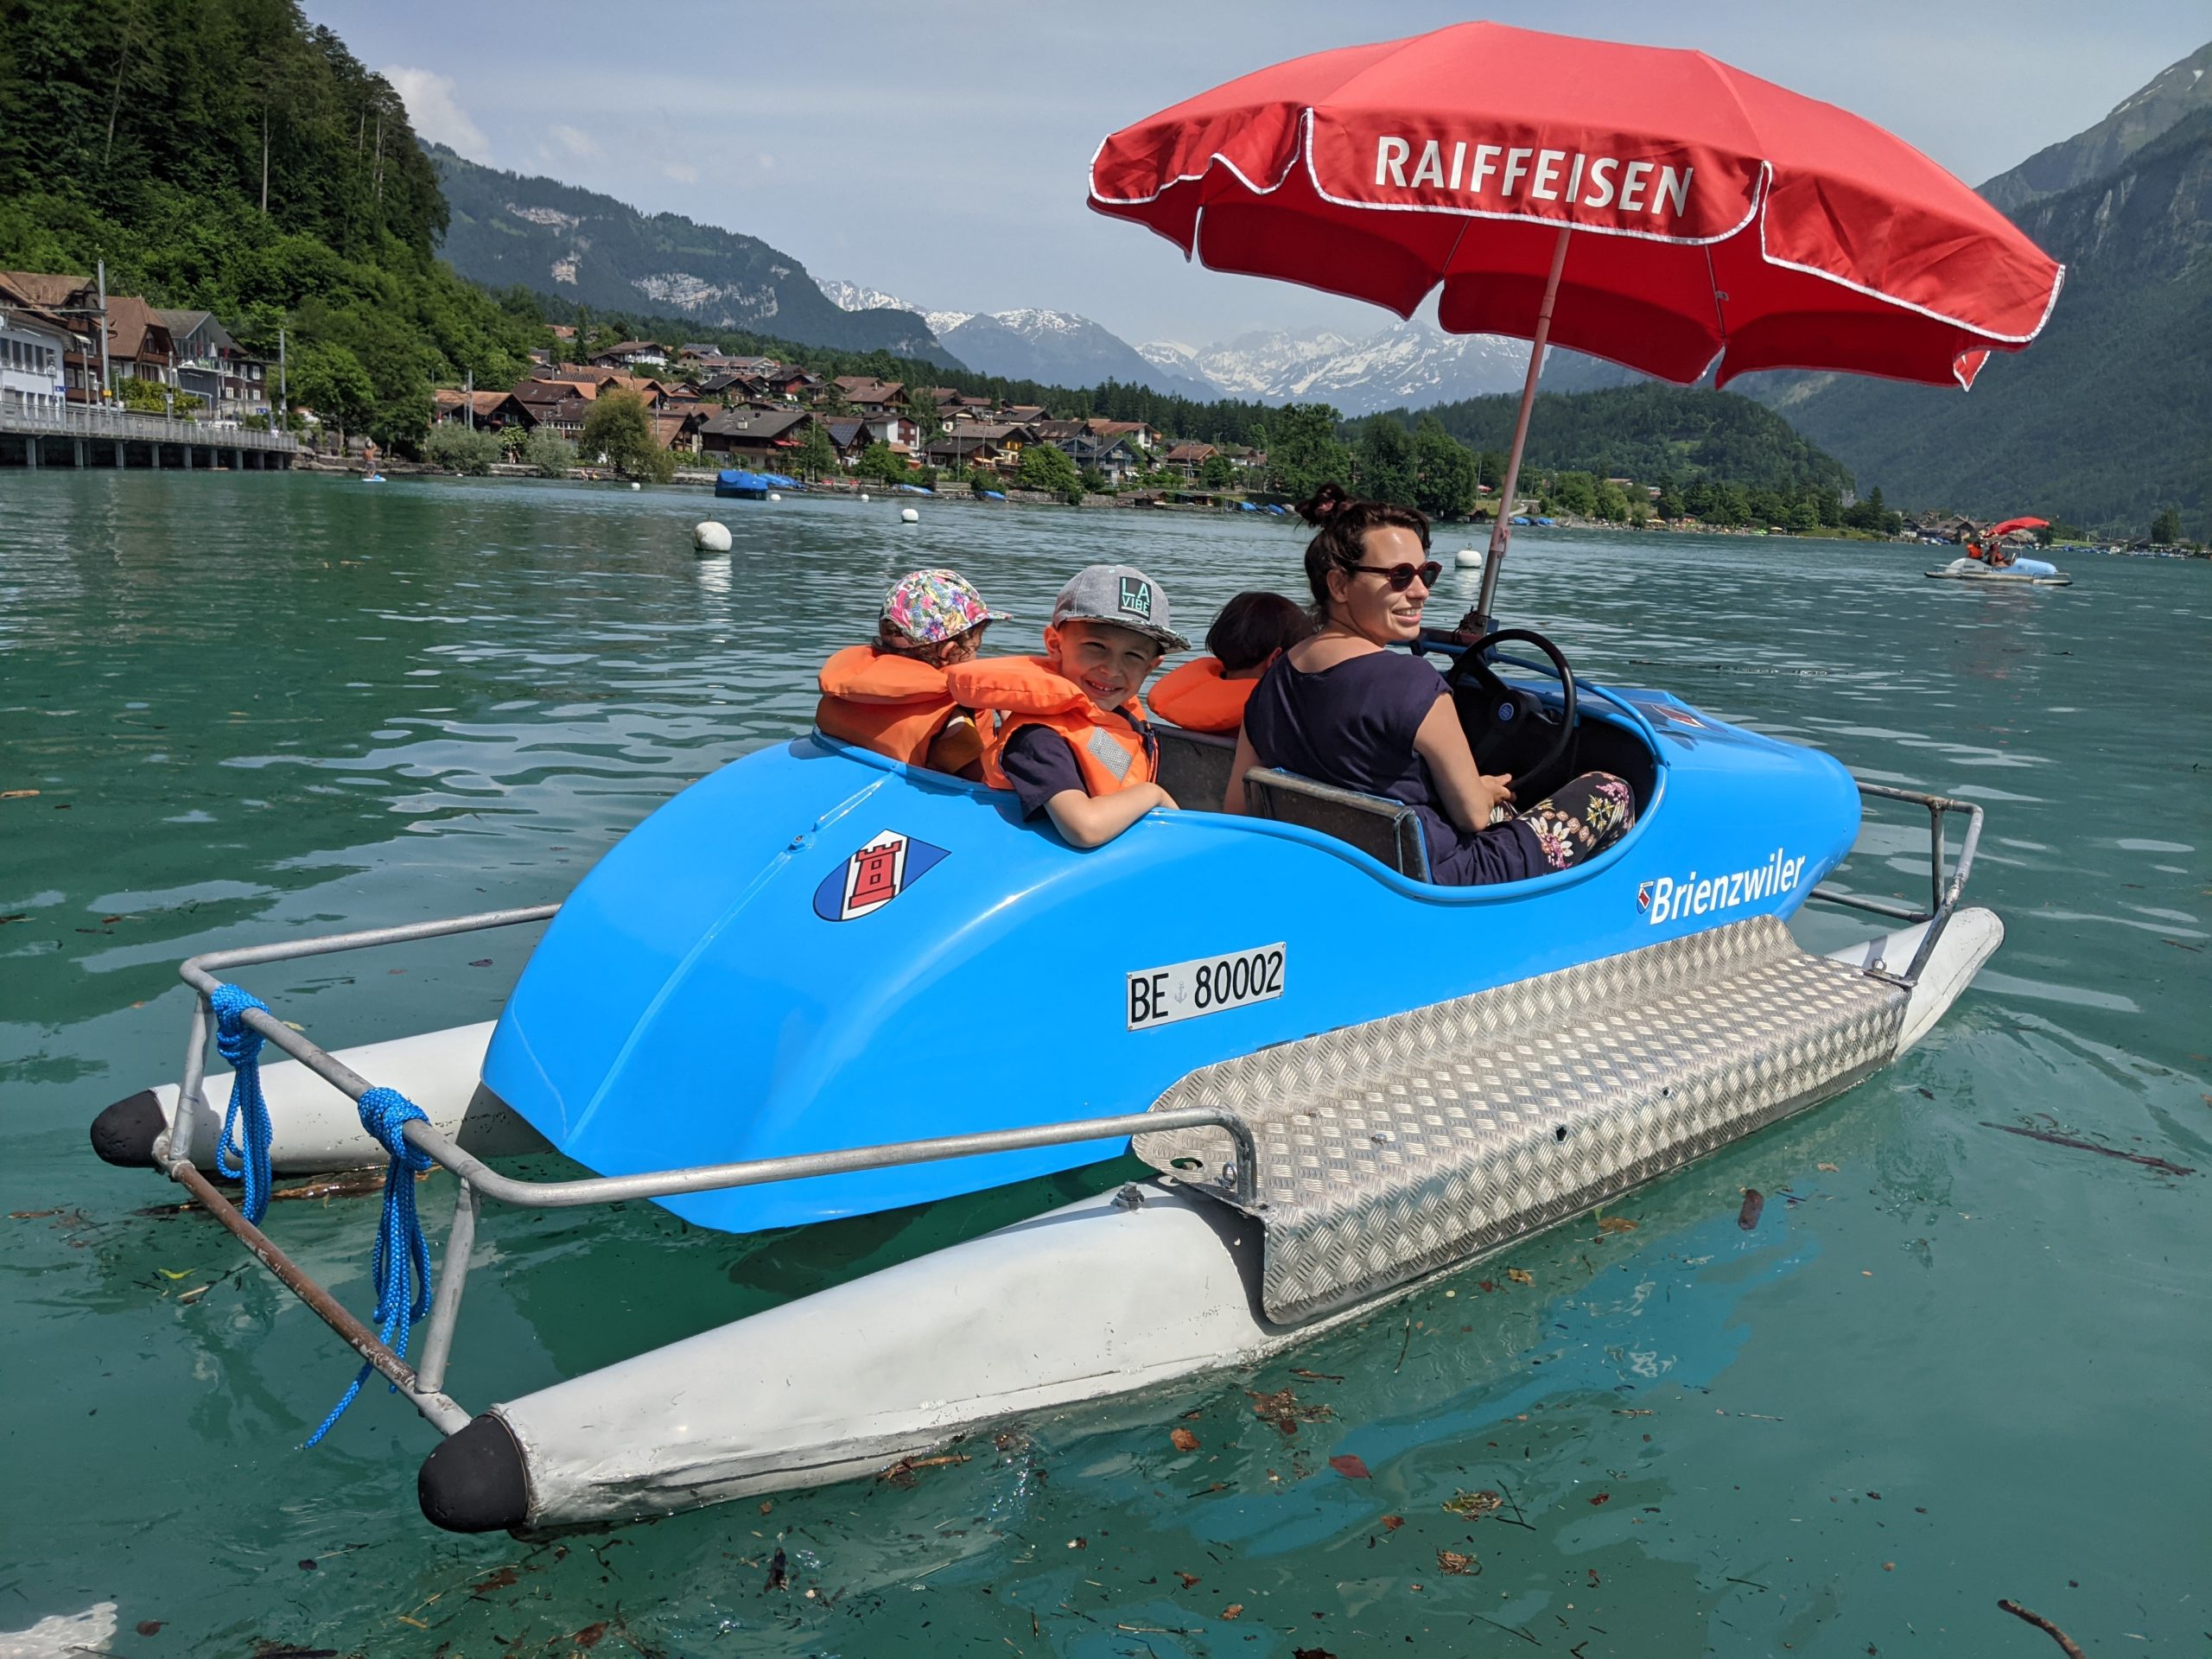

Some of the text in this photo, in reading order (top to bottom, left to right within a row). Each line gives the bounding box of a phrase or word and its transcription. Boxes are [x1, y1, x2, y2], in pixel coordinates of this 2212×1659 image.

[1375, 136, 1694, 218] RAIFFEISEN
[1122, 578, 1150, 603] LA
[1122, 596, 1150, 613] VIBE
[1649, 848, 1806, 925] Brienzwiler
[1131, 950, 1284, 1024] BE 80002
